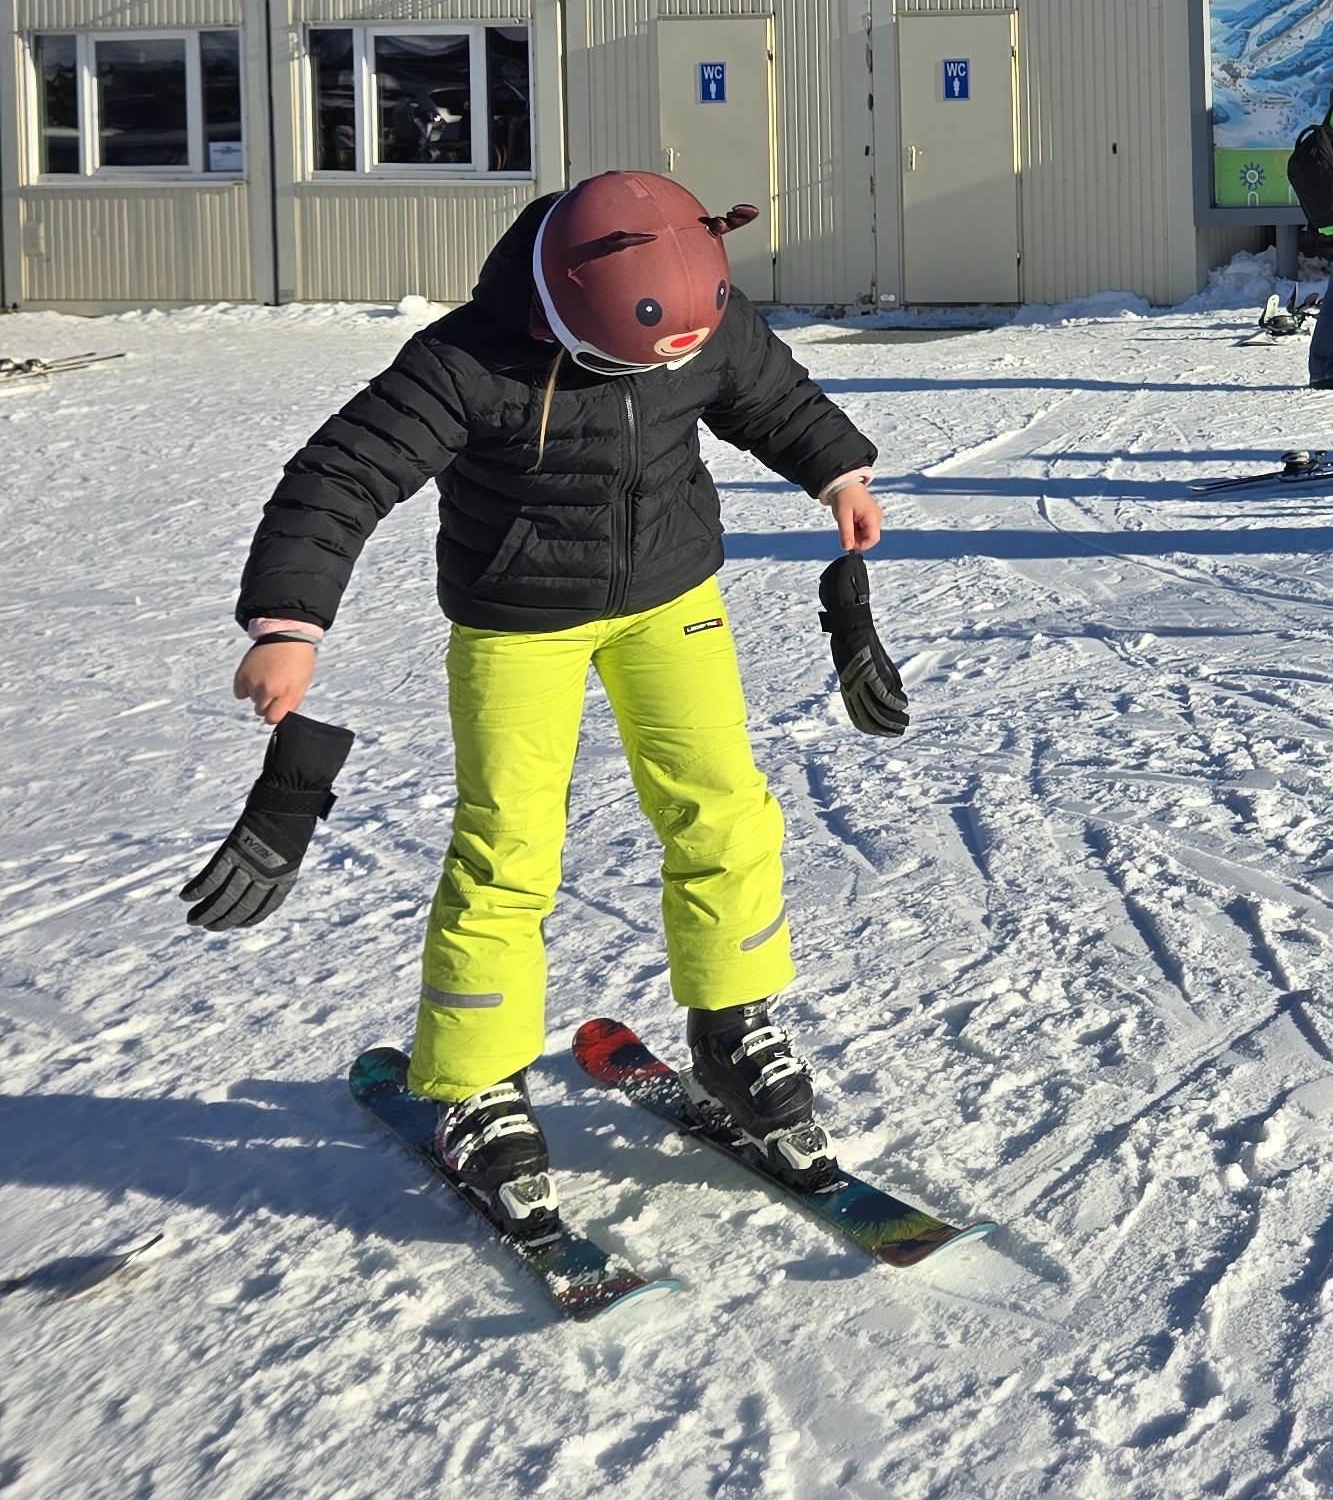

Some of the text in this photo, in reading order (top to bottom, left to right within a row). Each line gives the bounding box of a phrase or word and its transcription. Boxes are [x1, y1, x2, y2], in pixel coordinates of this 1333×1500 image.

[702, 65, 723, 80] WC
[945, 63, 967, 78] WC
[242, 834, 273, 860] RELAX
